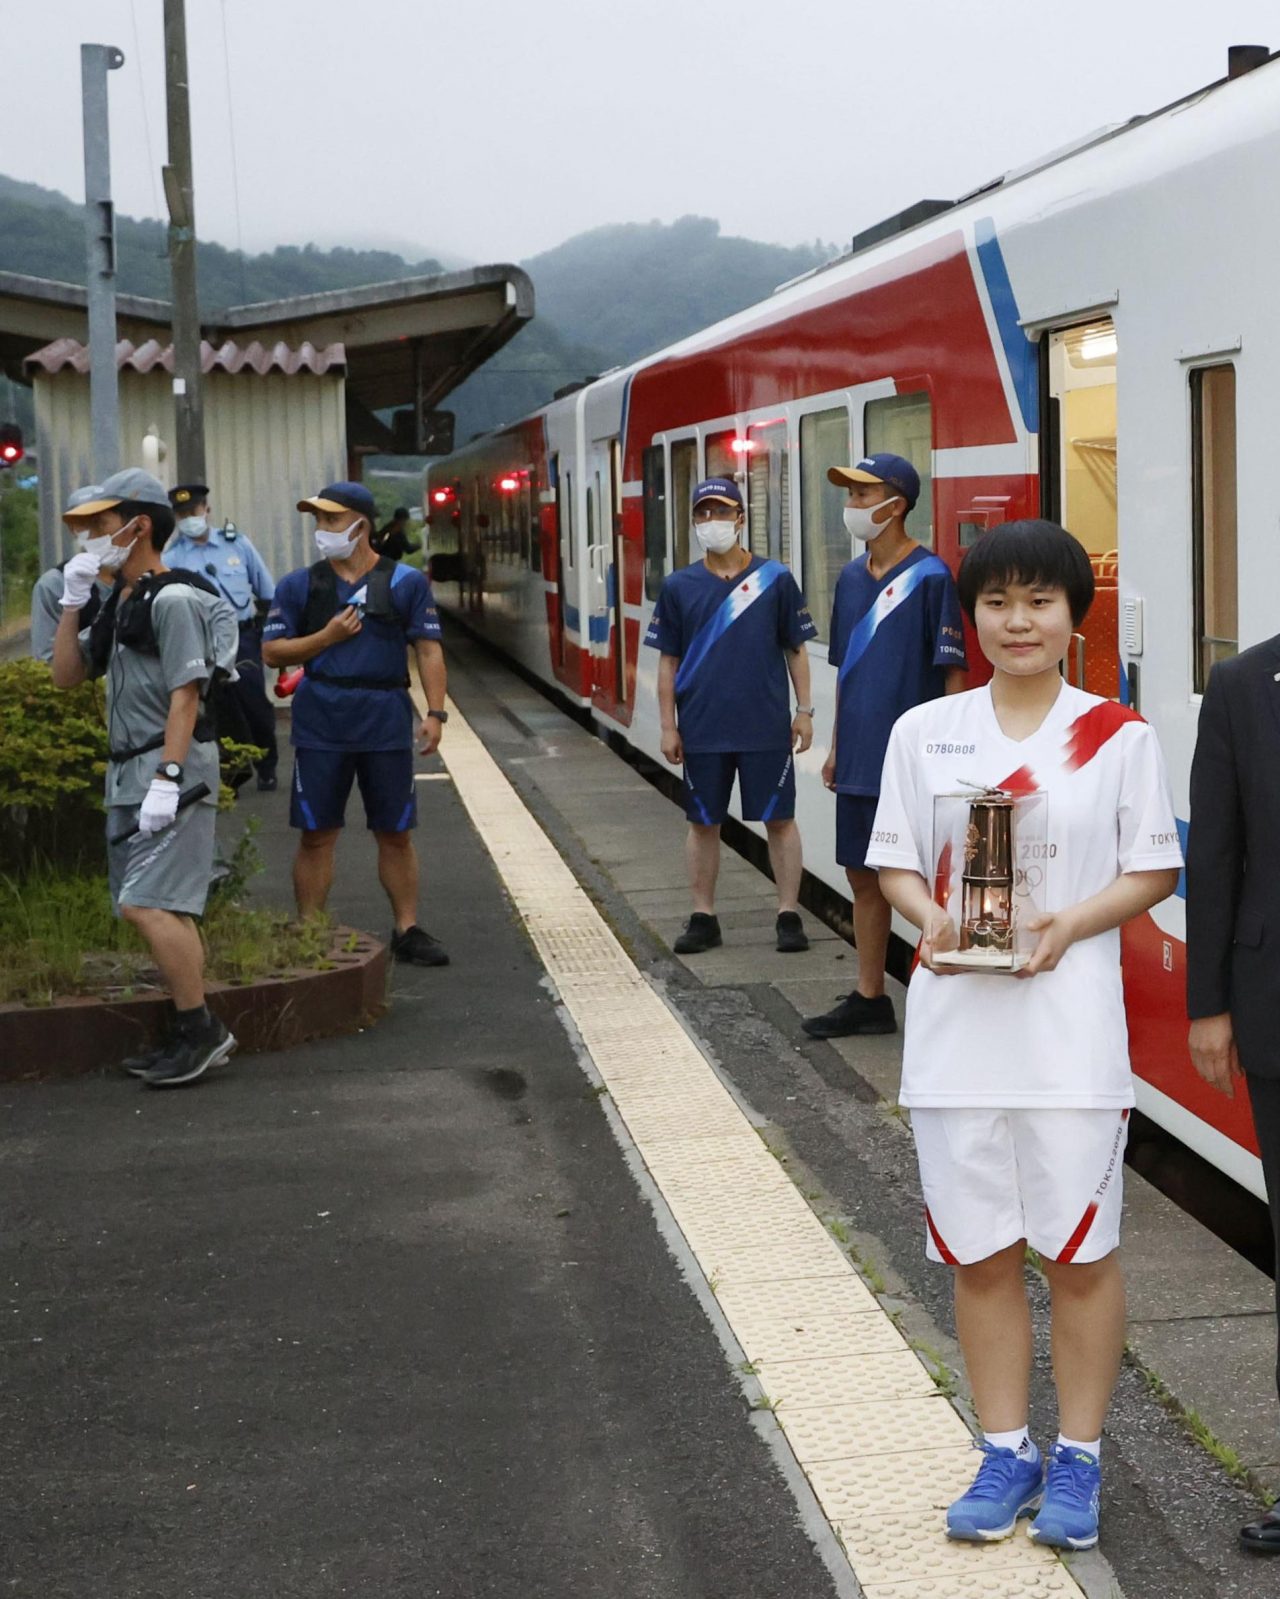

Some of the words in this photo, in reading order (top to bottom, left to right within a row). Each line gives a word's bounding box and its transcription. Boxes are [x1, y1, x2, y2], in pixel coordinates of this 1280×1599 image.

[926, 743, 976, 755] 0780808
[875, 831, 899, 844] 2020
[1095, 1158, 1115, 1196] TOKYO
[1112, 1127, 1123, 1157] 2020
